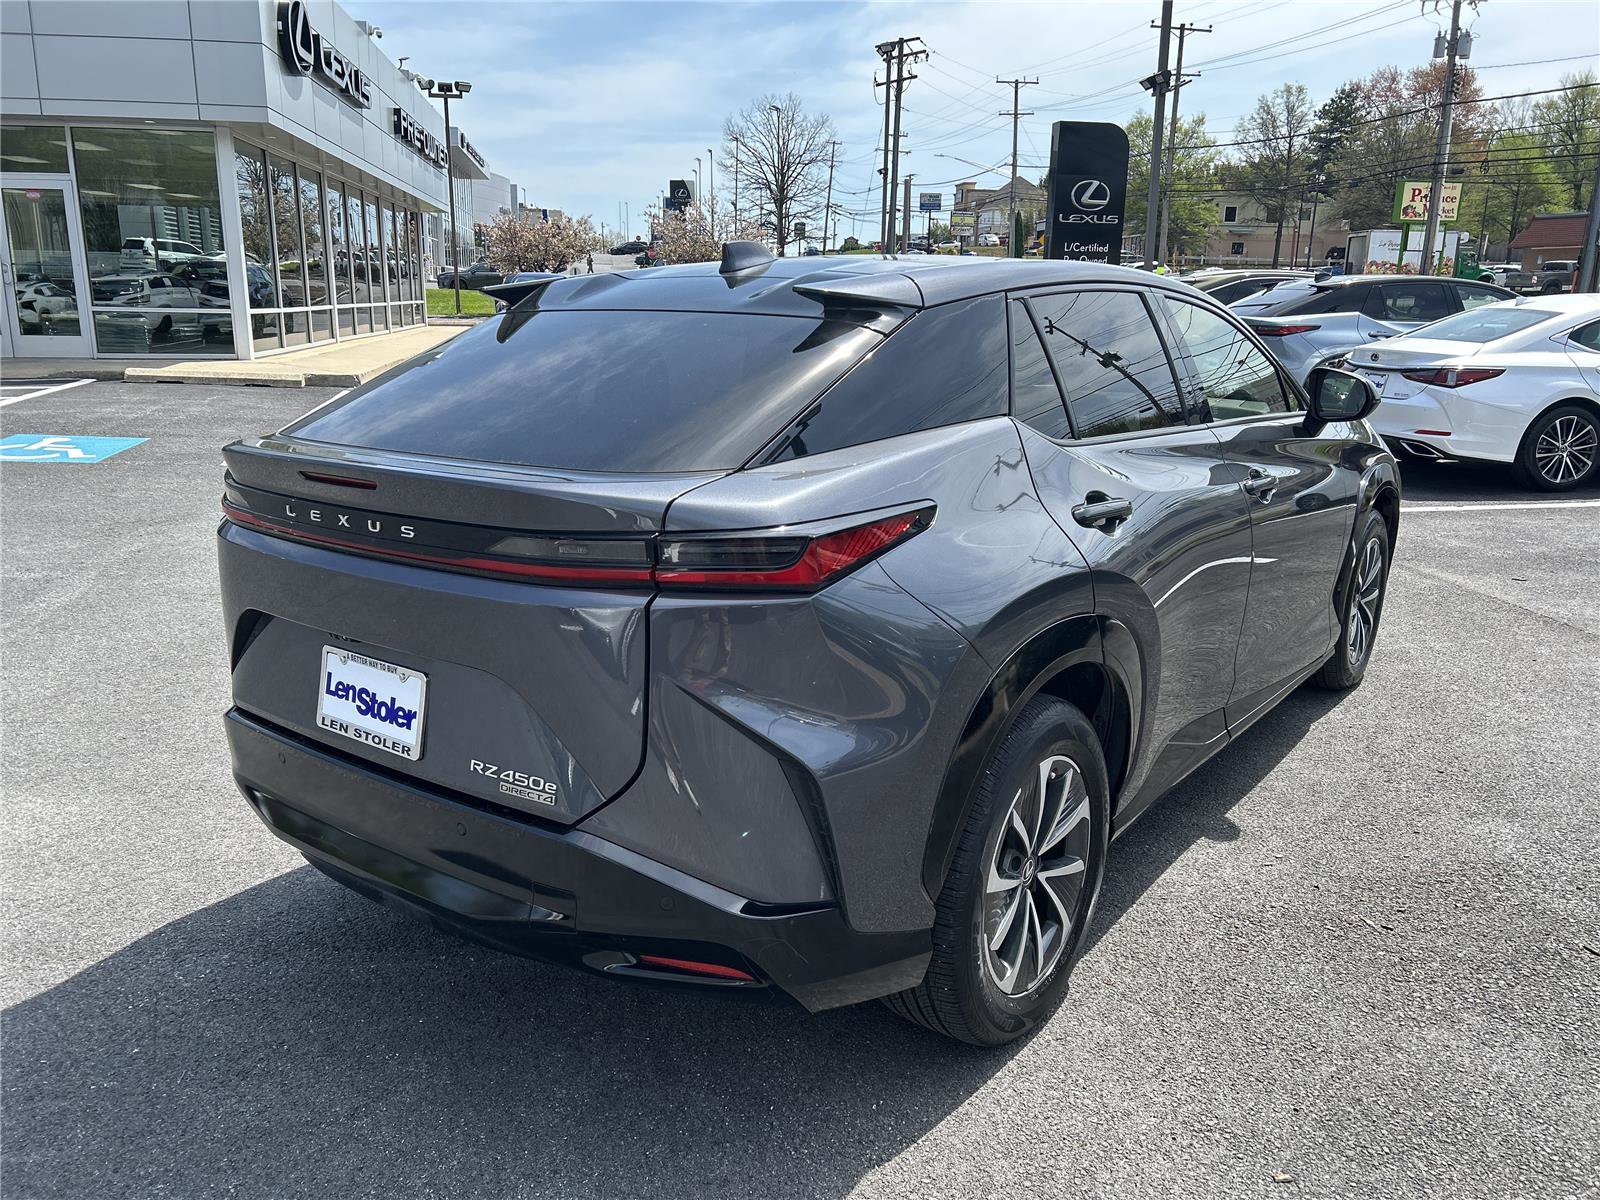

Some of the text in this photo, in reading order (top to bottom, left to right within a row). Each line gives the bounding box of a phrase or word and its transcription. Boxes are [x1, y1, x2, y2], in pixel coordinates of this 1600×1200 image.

[319, 38, 373, 109] LEXUS
[400, 109, 449, 169] PRE-OWNED
[1409, 187, 1457, 204] Proce
[1059, 213, 1119, 224] LEXUS
[1422, 204, 1455, 215] Mket
[1064, 242, 1109, 253] L/Certified
[285, 504, 416, 538] LEXUS
[351, 653, 368, 665] BETTER
[368, 660, 379, 669] WAY
[379, 663, 386, 671] TO
[386, 665, 398, 674] BUY
[321, 716, 412, 757] LEN STOLER
